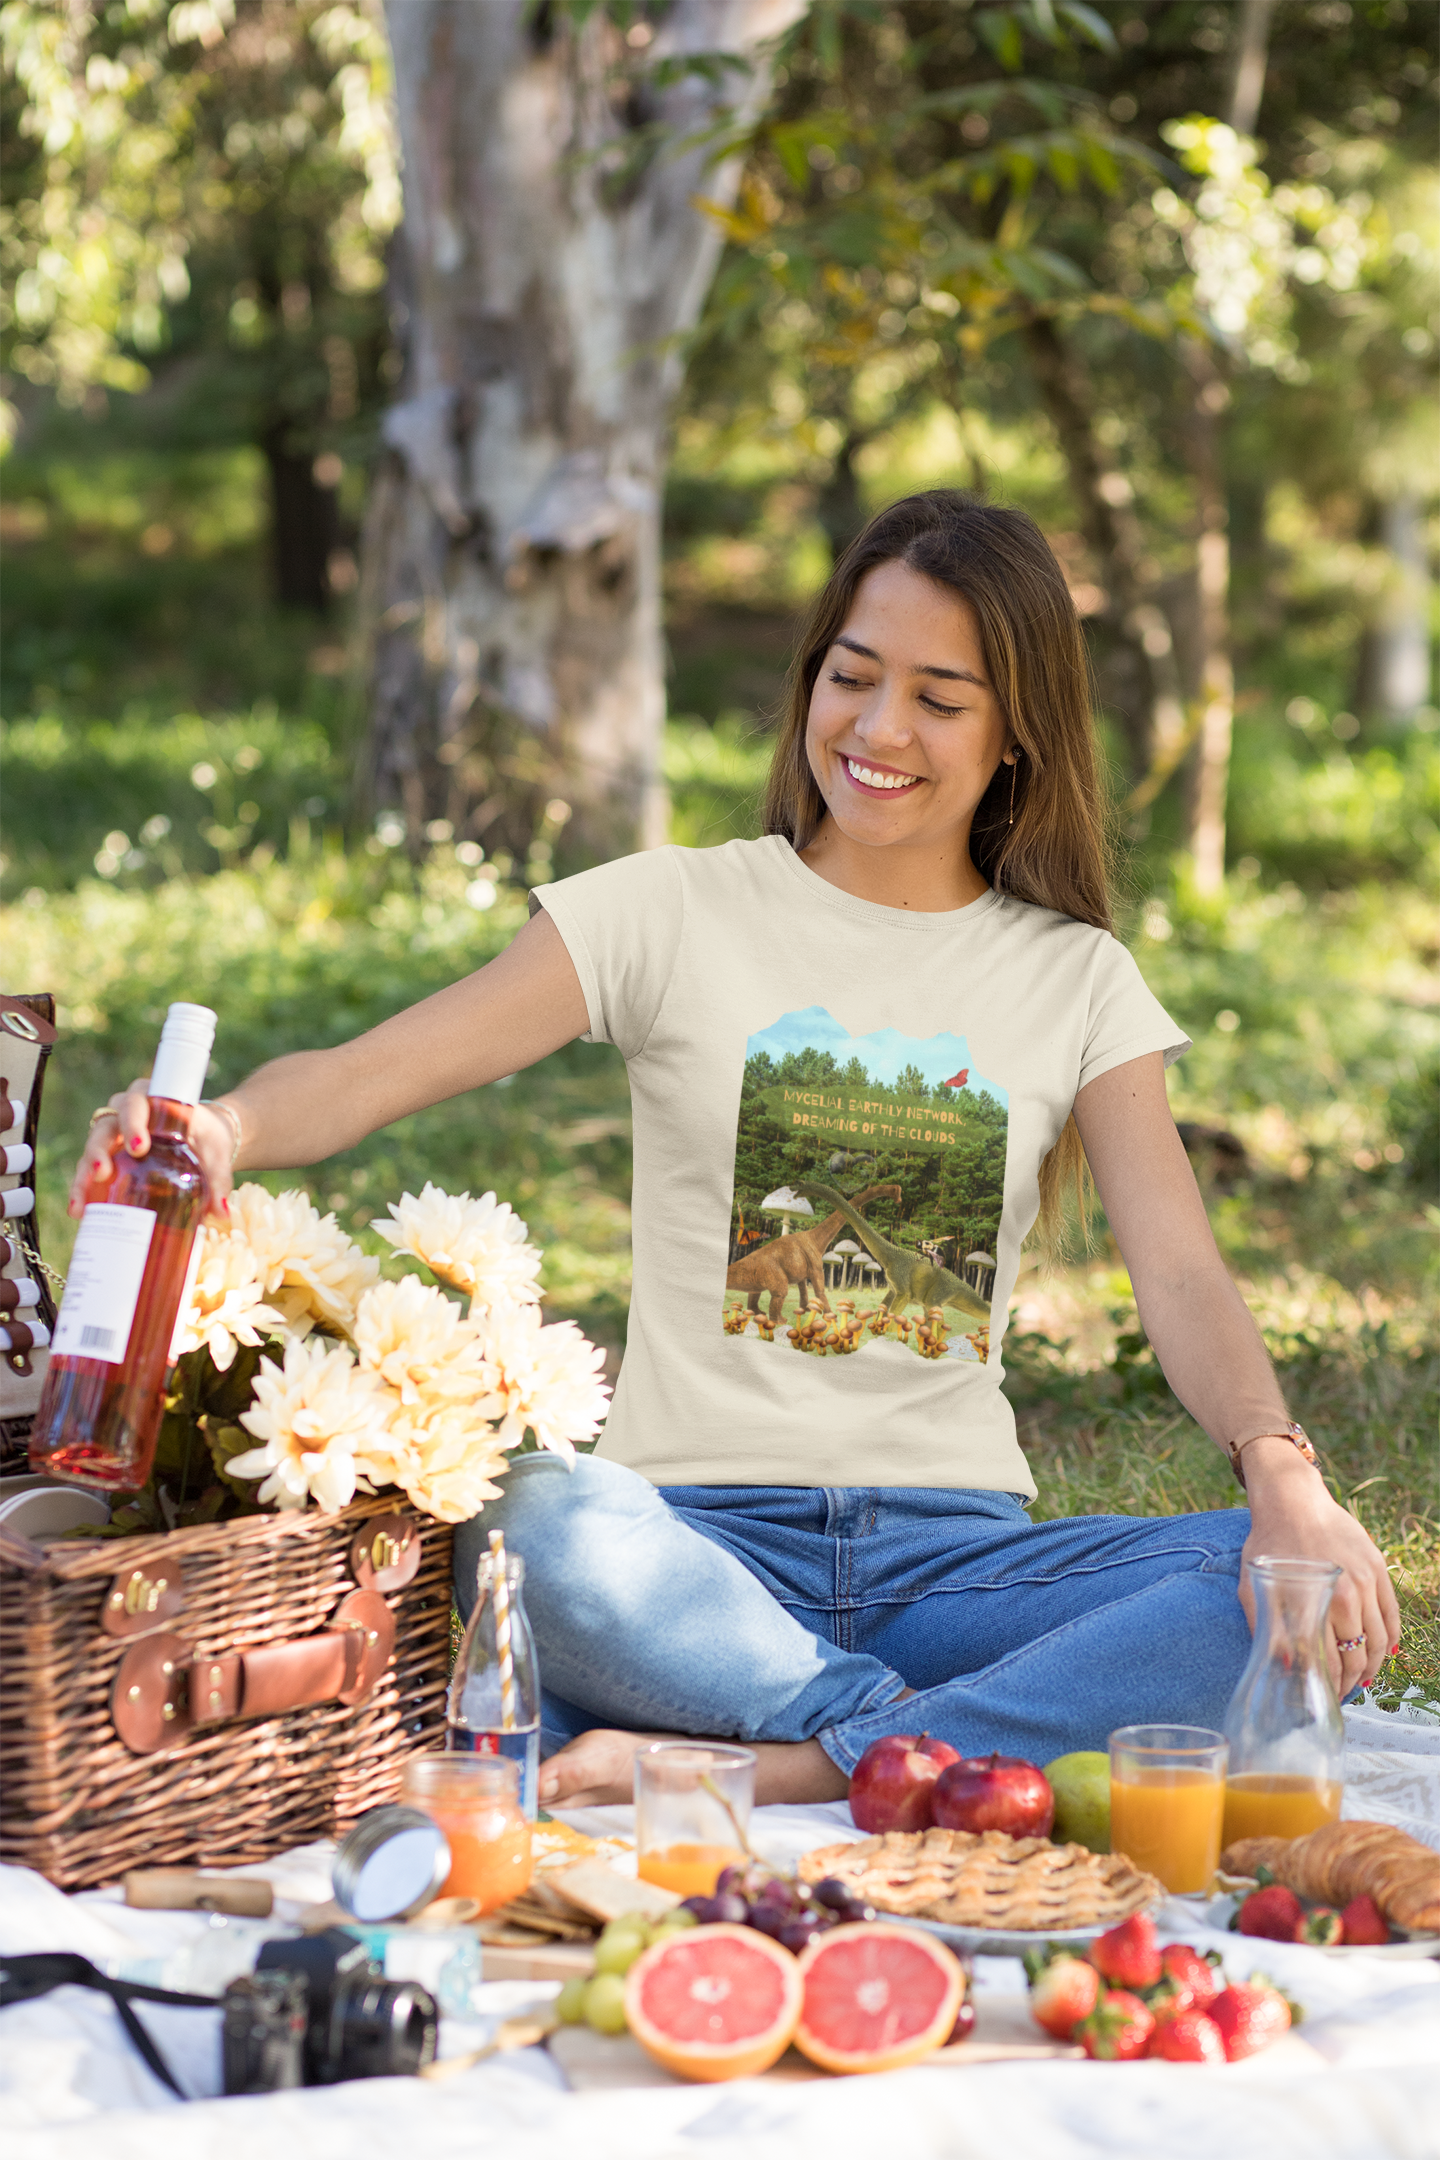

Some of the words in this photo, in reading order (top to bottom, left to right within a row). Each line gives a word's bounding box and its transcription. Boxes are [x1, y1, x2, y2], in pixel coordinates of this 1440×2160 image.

[783, 1089, 844, 1110] MYCELIAL
[848, 1099, 903, 1117] EARTHLY
[906, 1106, 967, 1127] NETWORK,
[792, 1112, 858, 1132] DREAMING
[861, 1121, 878, 1135] OF
[880, 1124, 906, 1139] THE
[909, 1128, 956, 1145] CLOUDS
